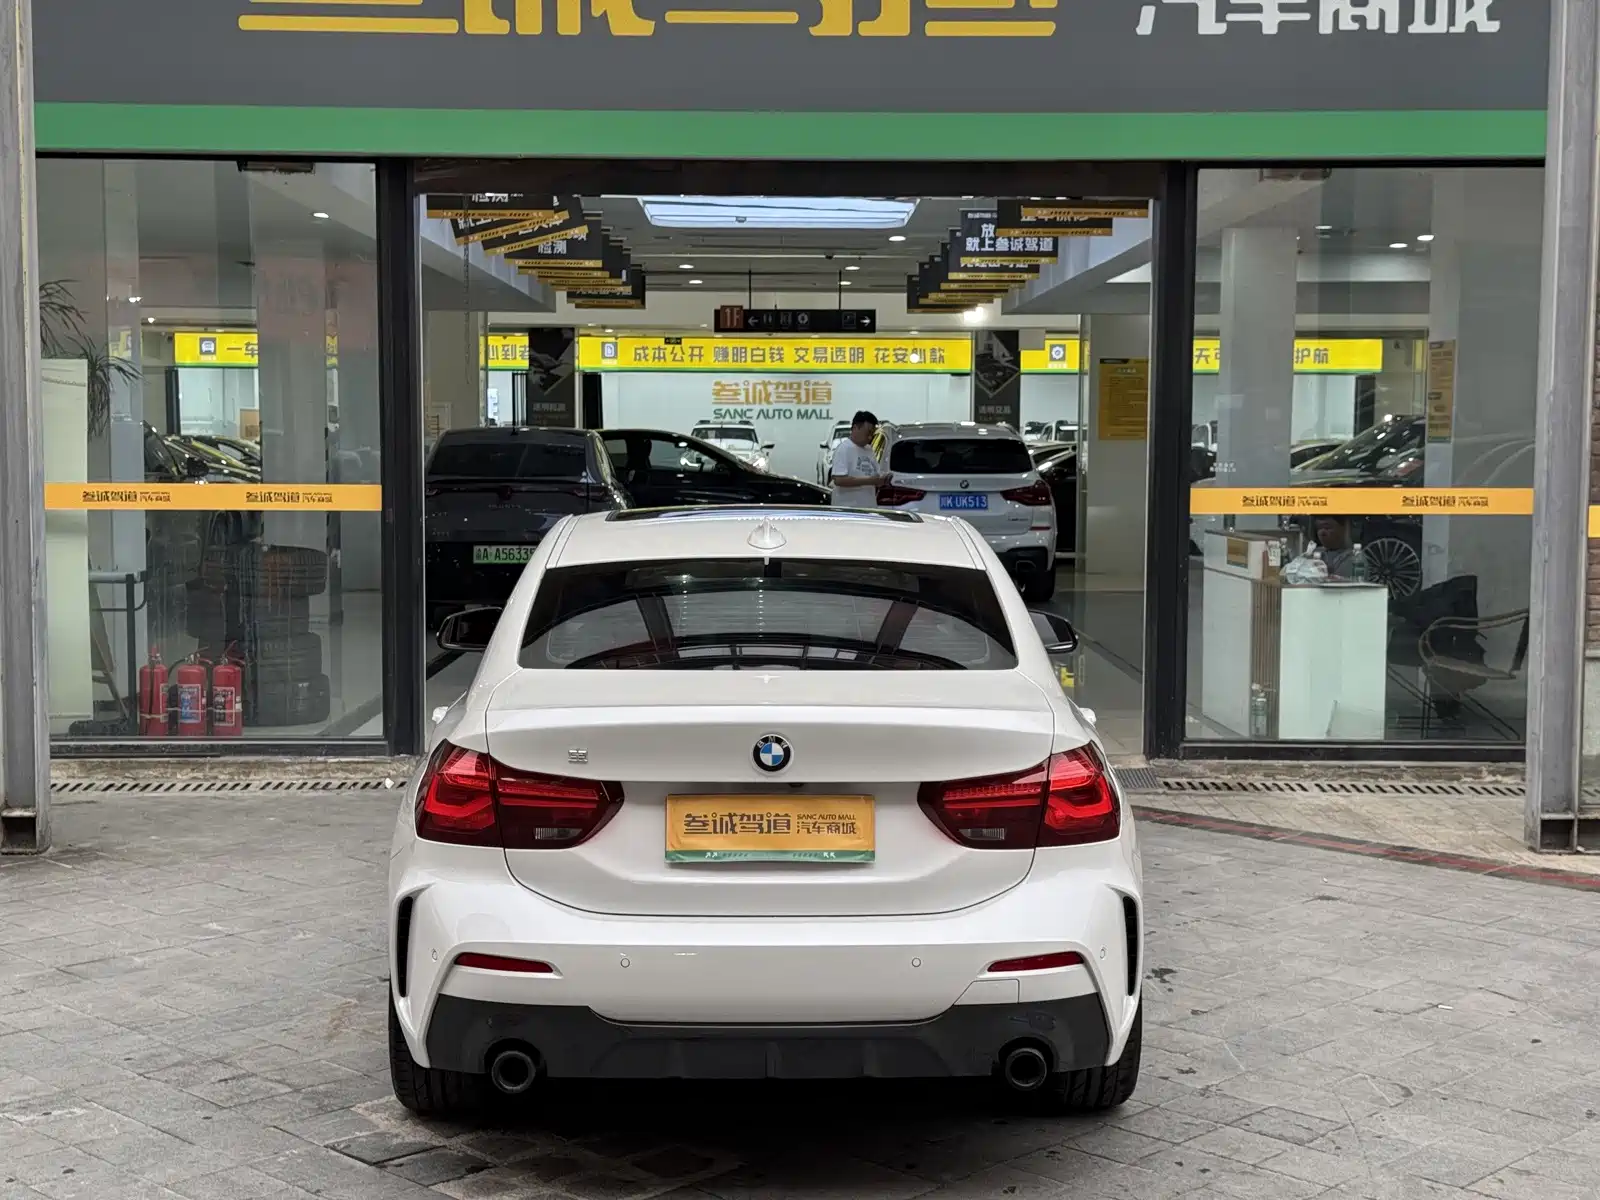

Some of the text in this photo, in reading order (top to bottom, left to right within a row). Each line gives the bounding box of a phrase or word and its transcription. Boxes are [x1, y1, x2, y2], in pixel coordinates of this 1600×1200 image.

[965, 237, 1053, 252] 就上叁诚驾道
[633, 346, 946, 364] 成本公开 赚明白钱 交易透明 花安心款
[1295, 347, 1329, 364] 护航
[711, 379, 833, 405] 叁诚驾道
[713, 408, 834, 420] SANC AUTO MALL
[756, 735, 789, 749] BMW
[683, 811, 791, 835] 叁诚驾道
[797, 821, 857, 835] 汽车商城
